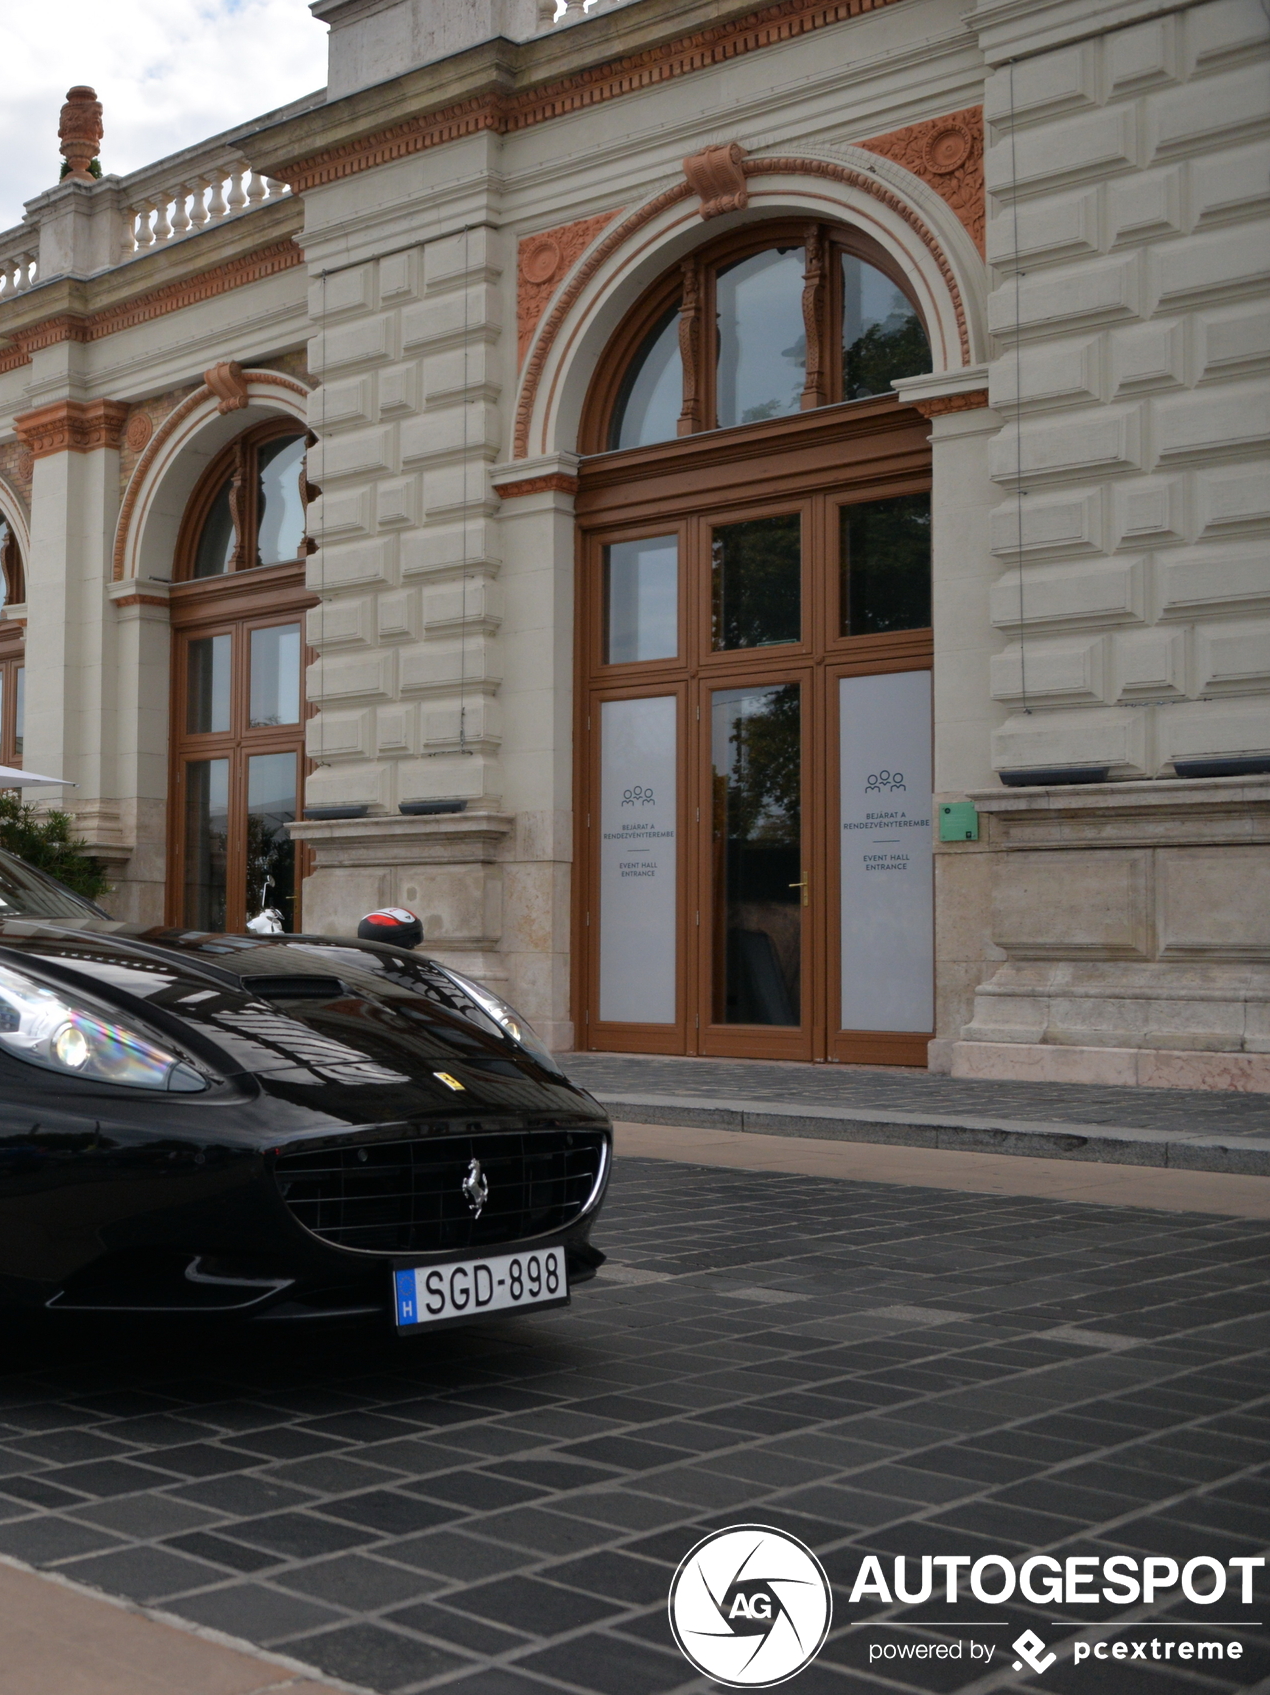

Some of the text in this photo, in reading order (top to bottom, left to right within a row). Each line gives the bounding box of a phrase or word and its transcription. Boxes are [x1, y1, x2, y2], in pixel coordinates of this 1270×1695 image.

[866, 811, 898, 820] BEJÁRAT
[844, 820, 930, 830] RENDEZVÉNYTEREMBE
[604, 830, 674, 840] RENDEZVÉNYTEREMBE
[865, 863, 907, 871] ENTRANCE
[425, 1252, 560, 1315] SGD-898
[402, 1300, 413, 1318] H
